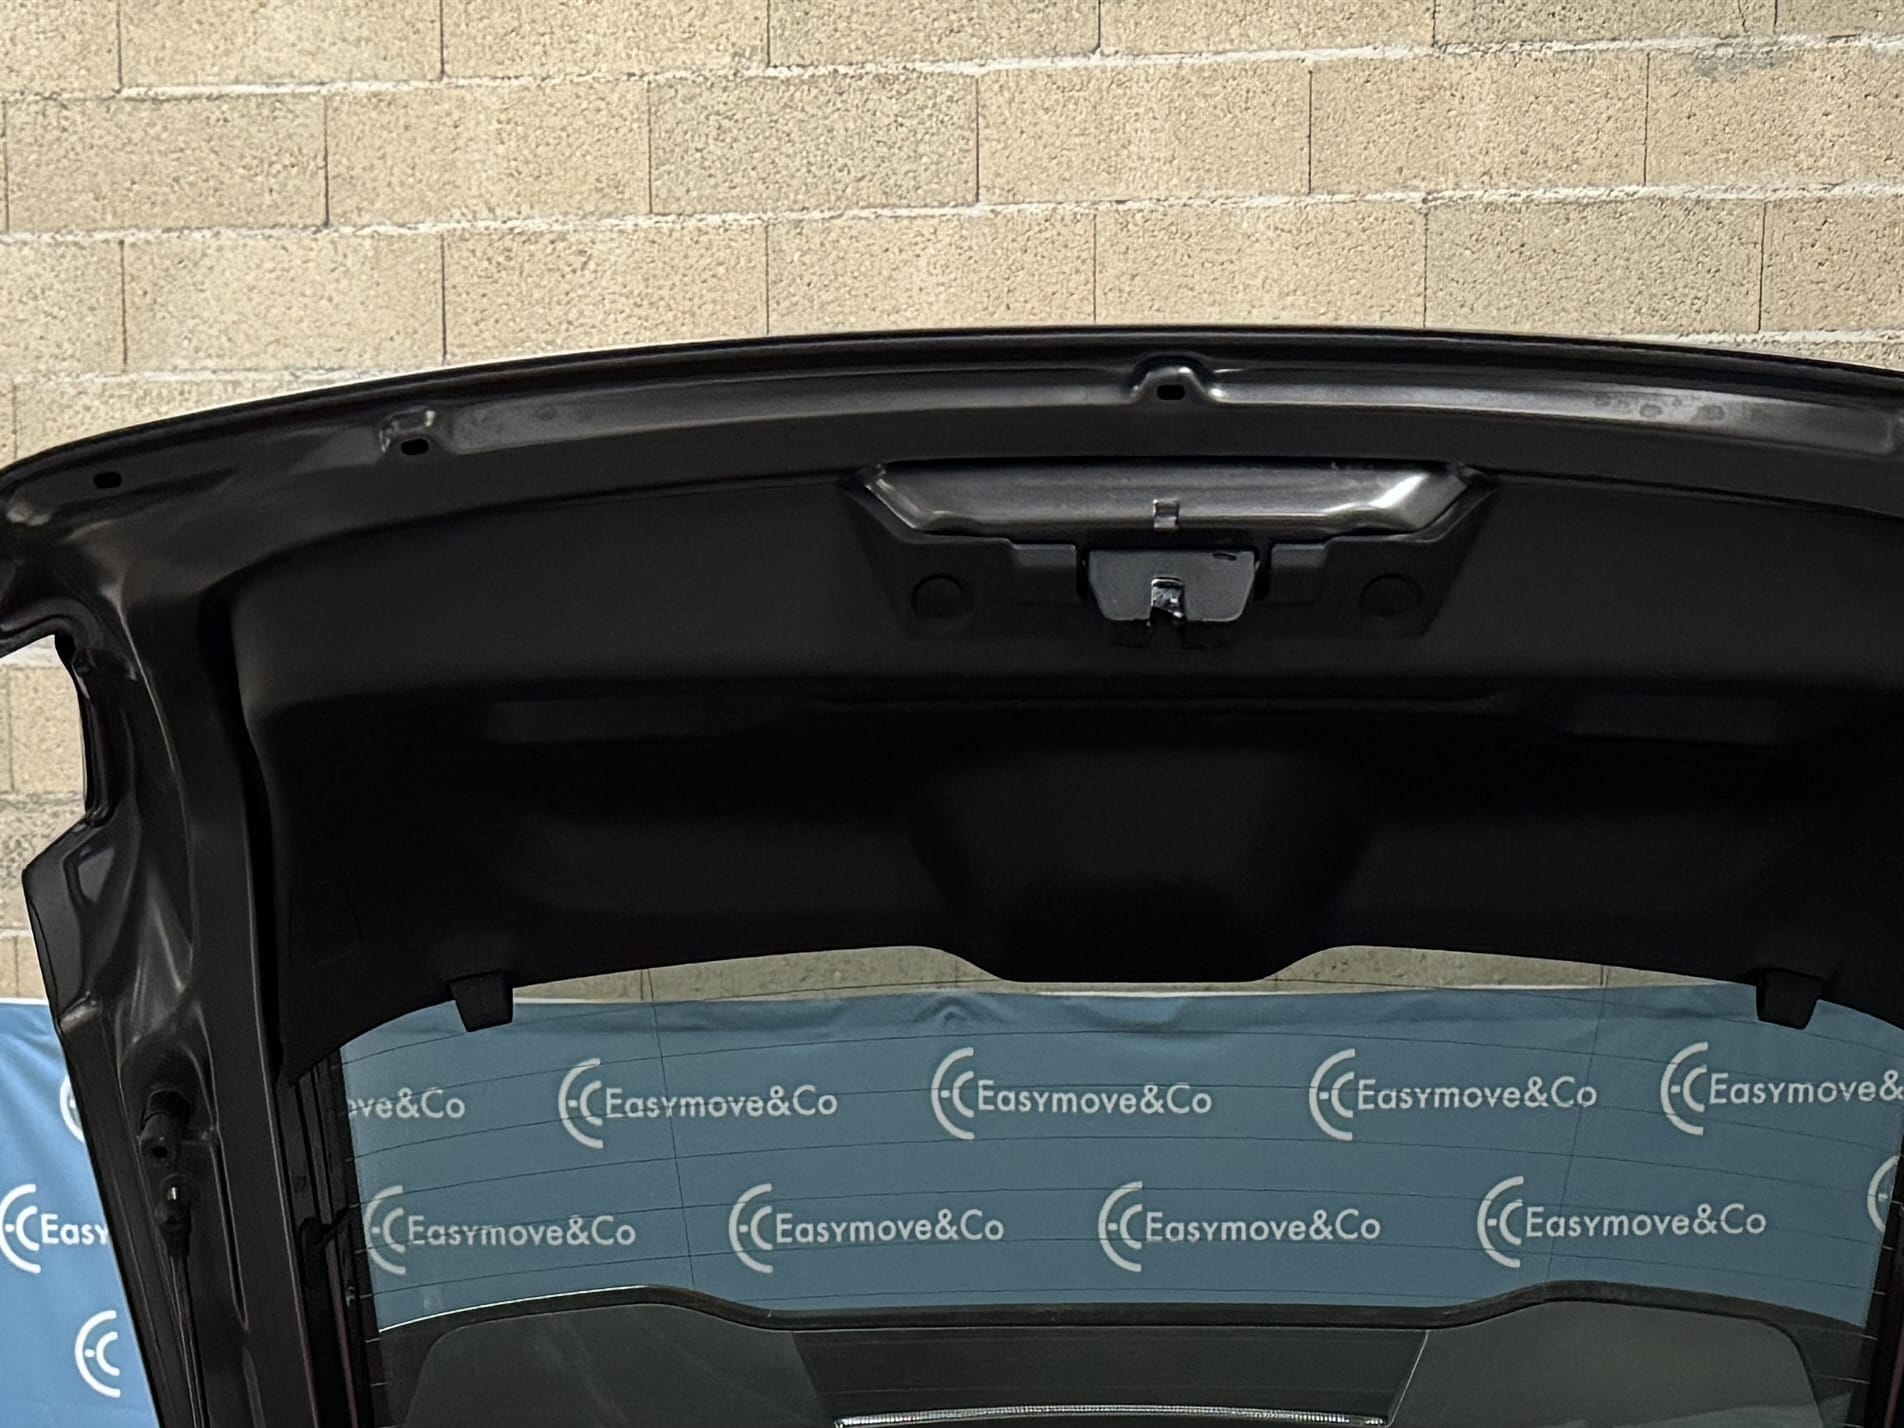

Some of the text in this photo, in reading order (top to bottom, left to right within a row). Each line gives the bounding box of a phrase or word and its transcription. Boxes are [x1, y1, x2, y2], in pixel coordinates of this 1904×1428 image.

[604, 1083, 838, 1119] Easymove&Co
[976, 1078, 1213, 1115] Easymove&Co
[1356, 1075, 1597, 1110] Easymove&Co
[406, 1213, 637, 1247] Easymove&Co
[775, 1207, 1006, 1244] Easymove&Co
[1145, 1207, 1382, 1243] Easymove&Co
[1524, 1202, 1767, 1238] Easymove&Co
